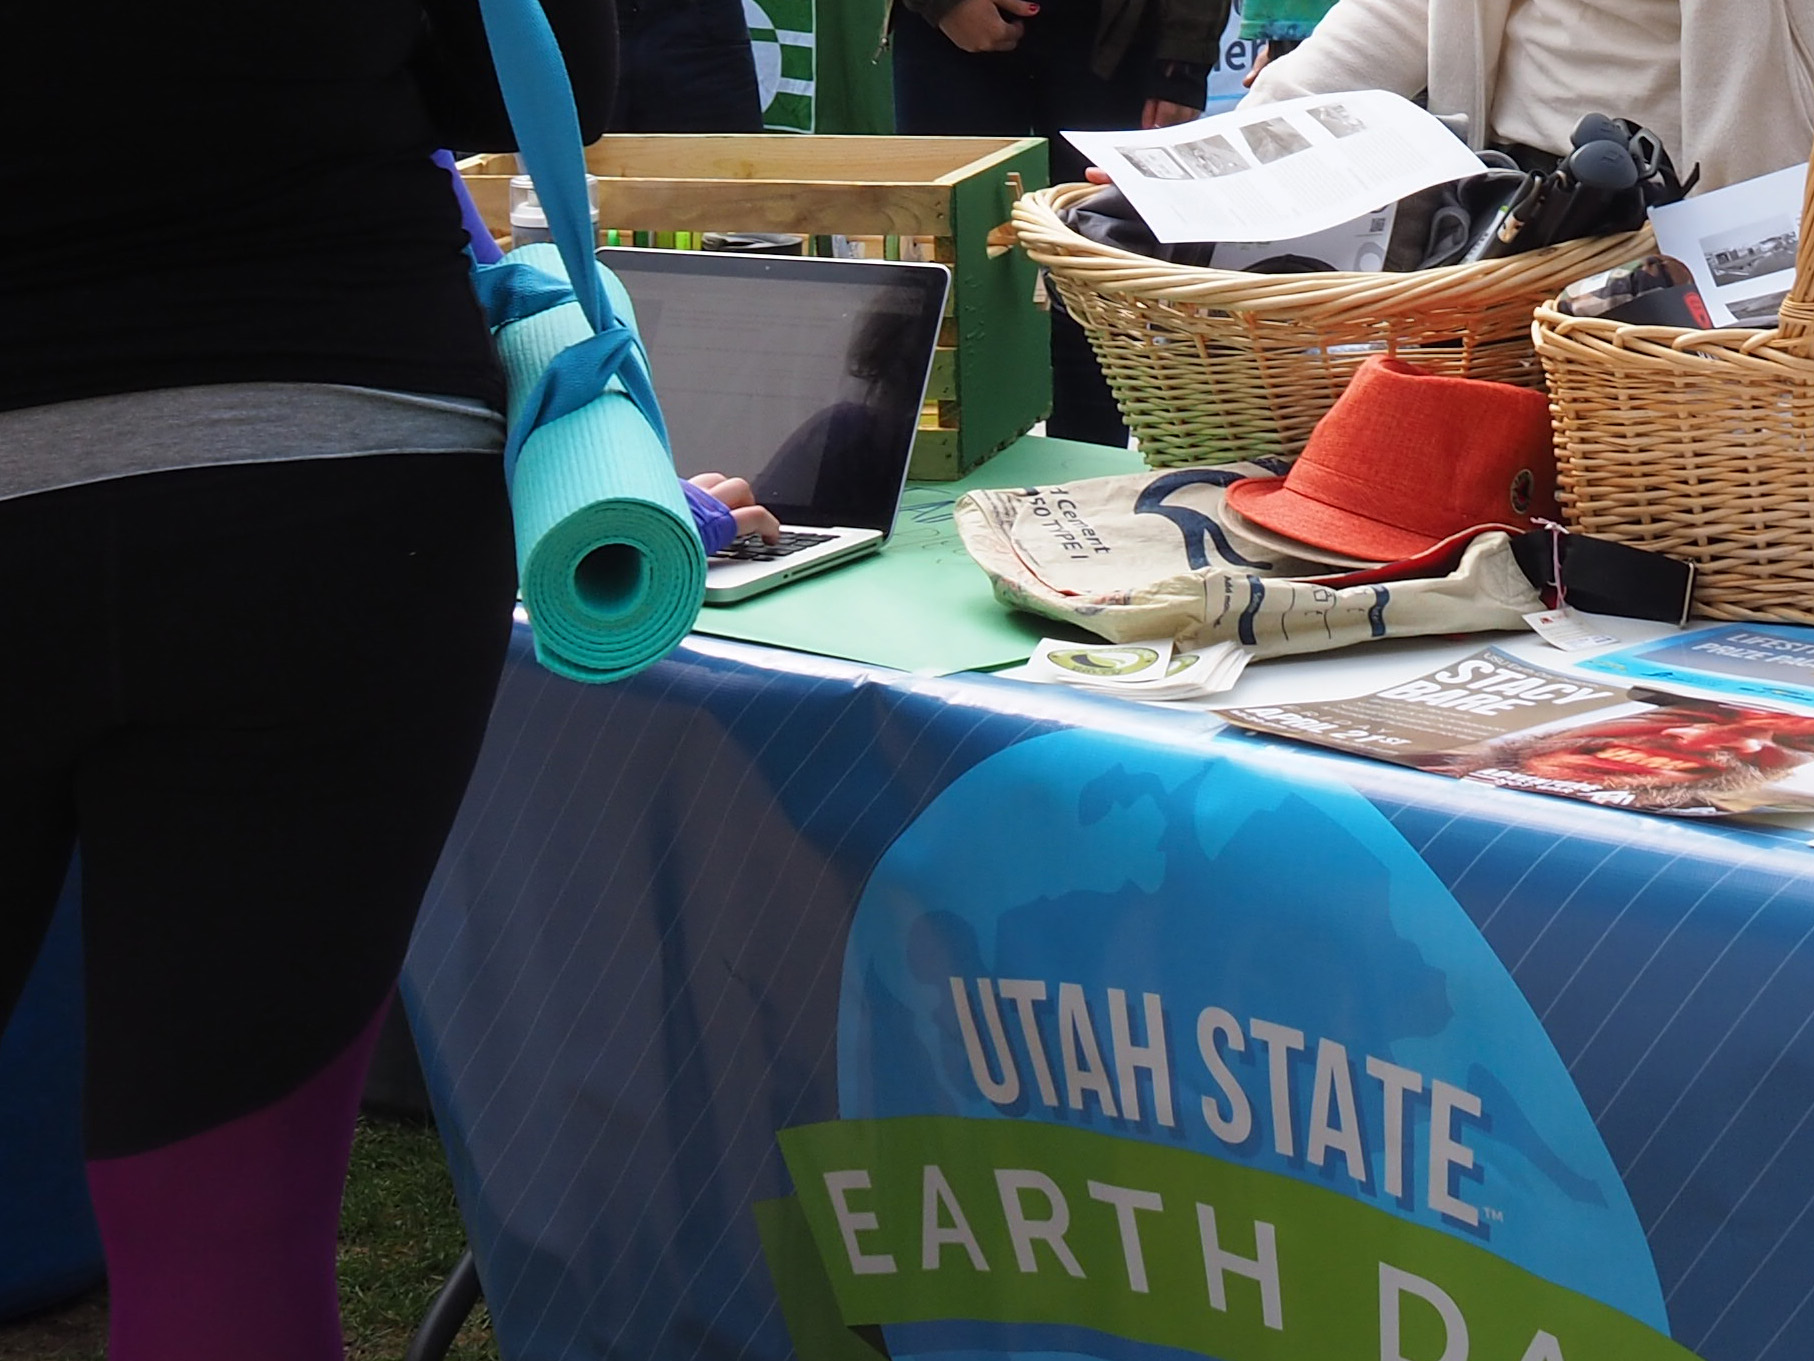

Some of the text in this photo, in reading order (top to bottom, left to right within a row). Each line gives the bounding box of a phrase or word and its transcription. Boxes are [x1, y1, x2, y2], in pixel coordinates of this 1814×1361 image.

[1042, 520, 1083, 550] TYPE
[1057, 499, 1112, 554] Cement
[1691, 643, 1773, 660] PRIZE
[1376, 680, 1536, 716] BARE
[1435, 659, 1614, 705] STACY
[1245, 707, 1339, 734] APRIL
[949, 977, 1176, 1128] UTAH
[1197, 1006, 1483, 1228] STATE
[823, 1164, 1284, 1332] EARTH
